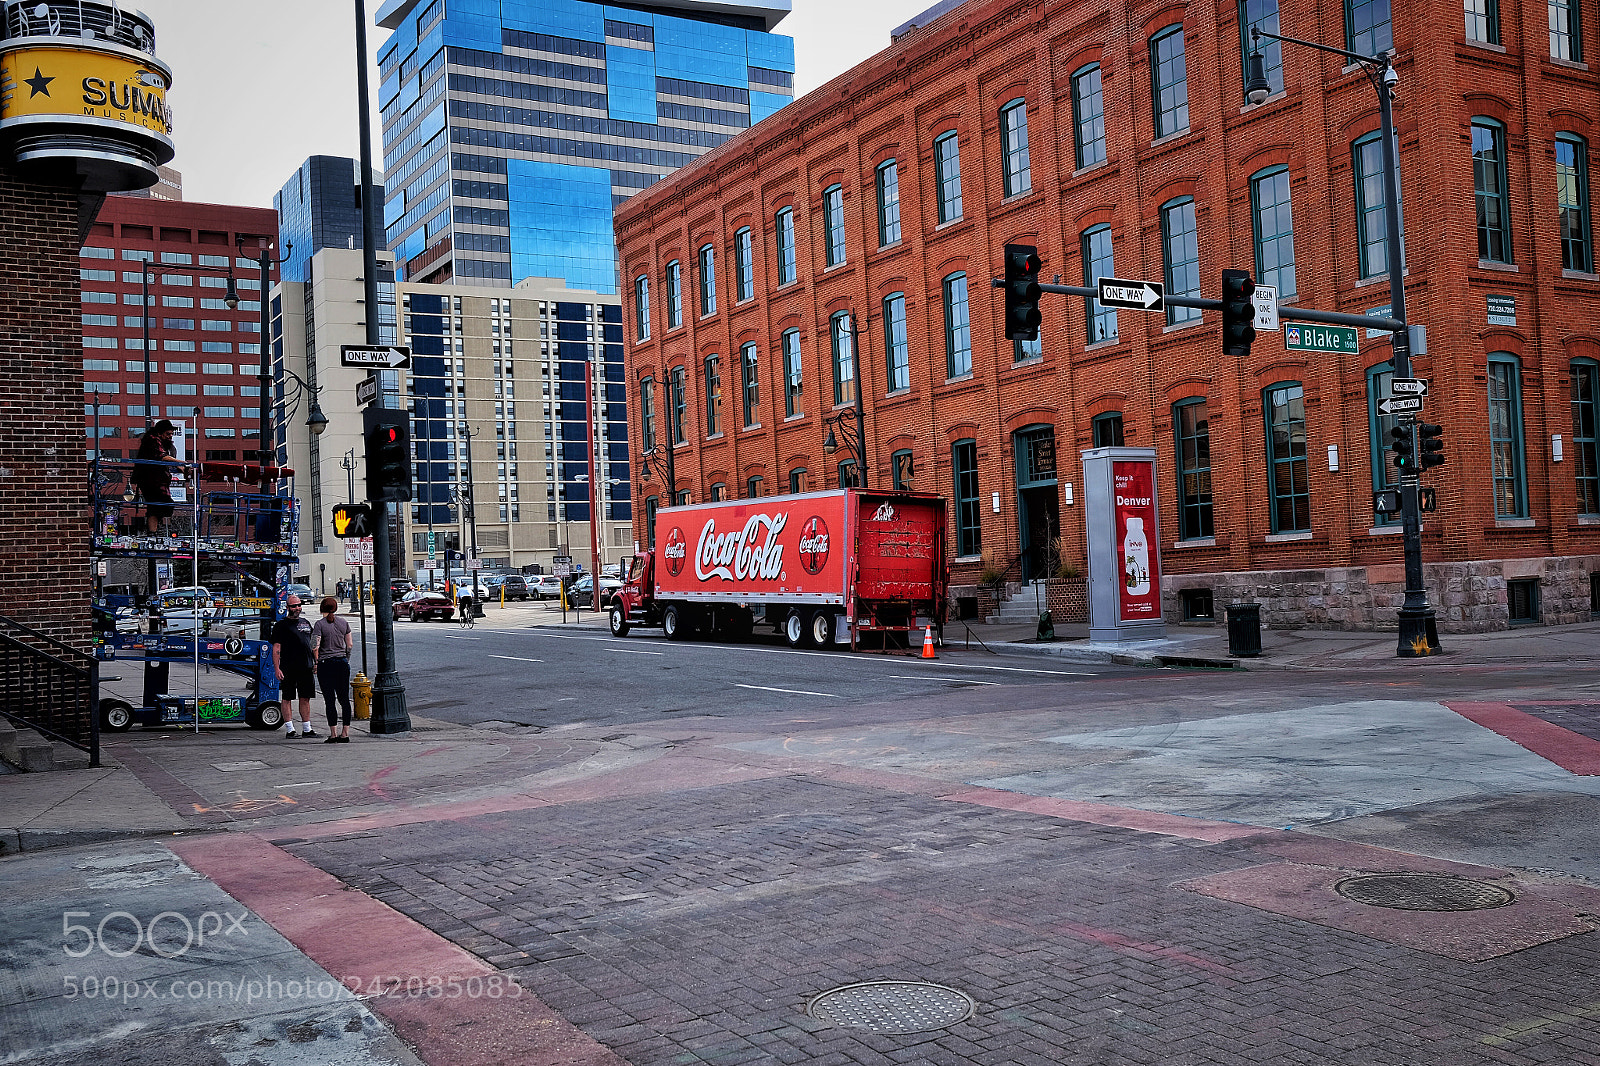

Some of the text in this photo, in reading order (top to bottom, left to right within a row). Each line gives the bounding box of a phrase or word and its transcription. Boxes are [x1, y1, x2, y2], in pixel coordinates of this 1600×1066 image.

[83, 106, 149, 128] MUSIC
[1106, 286, 1145, 301] ONE WAY
[1256, 290, 1273, 299] BEGIN
[1259, 304, 1271, 313] ONE
[1259, 316, 1272, 325] WAY
[1304, 329, 1340, 348] Blake
[348, 351, 390, 362] ONE WAY
[1394, 383, 1418, 391] ONE WAY
[1390, 399, 1418, 409] ONE WAY
[1115, 474, 1129, 482] Keep
[1116, 495, 1151, 506] Denver
[695, 512, 788, 582] Coca-Cola
[799, 533, 829, 554] Coca-Cola
